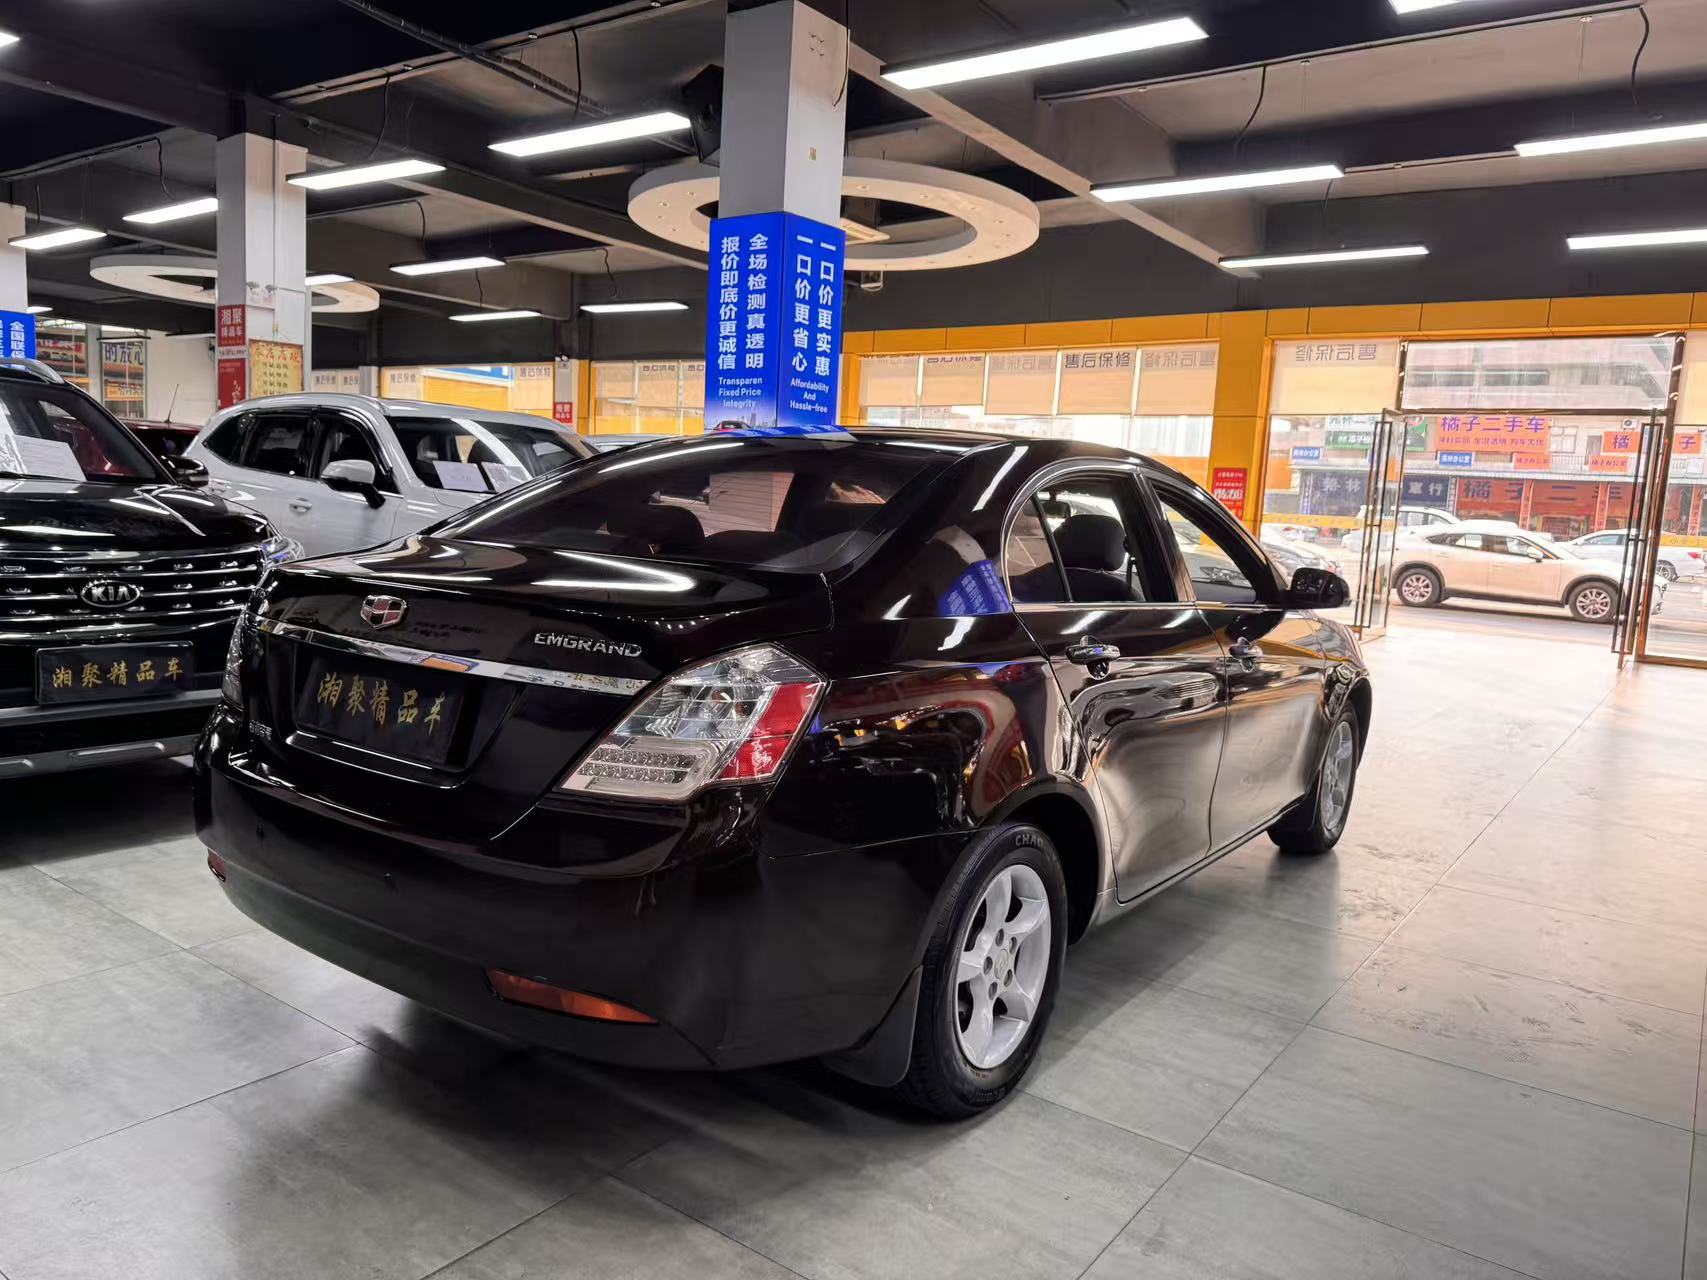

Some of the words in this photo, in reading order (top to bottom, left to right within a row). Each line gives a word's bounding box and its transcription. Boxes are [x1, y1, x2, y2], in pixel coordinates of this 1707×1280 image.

[718, 236, 740, 370] 报价即底价更诚信
[745, 233, 768, 369] 全场检测真透明
[792, 234, 813, 372] 一口价更省心
[815, 242, 836, 377] 一口价更实惠
[1065, 352, 1131, 369] 售后保修
[718, 387, 740, 397] Fixed
[741, 387, 762, 396] Price
[790, 378, 830, 394] Affordability
[723, 399, 756, 409] Integrity
[803, 391, 817, 401] And
[790, 400, 828, 414] Hassle-free
[1440, 415, 1545, 433] 橘子二手车
[1679, 435, 1697, 449] 子
[92, 586, 131, 601] KIA
[534, 632, 643, 658] EMGRAND
[52, 656, 184, 689] 湘聚精品车
[317, 671, 446, 737] 湘聚精品车
